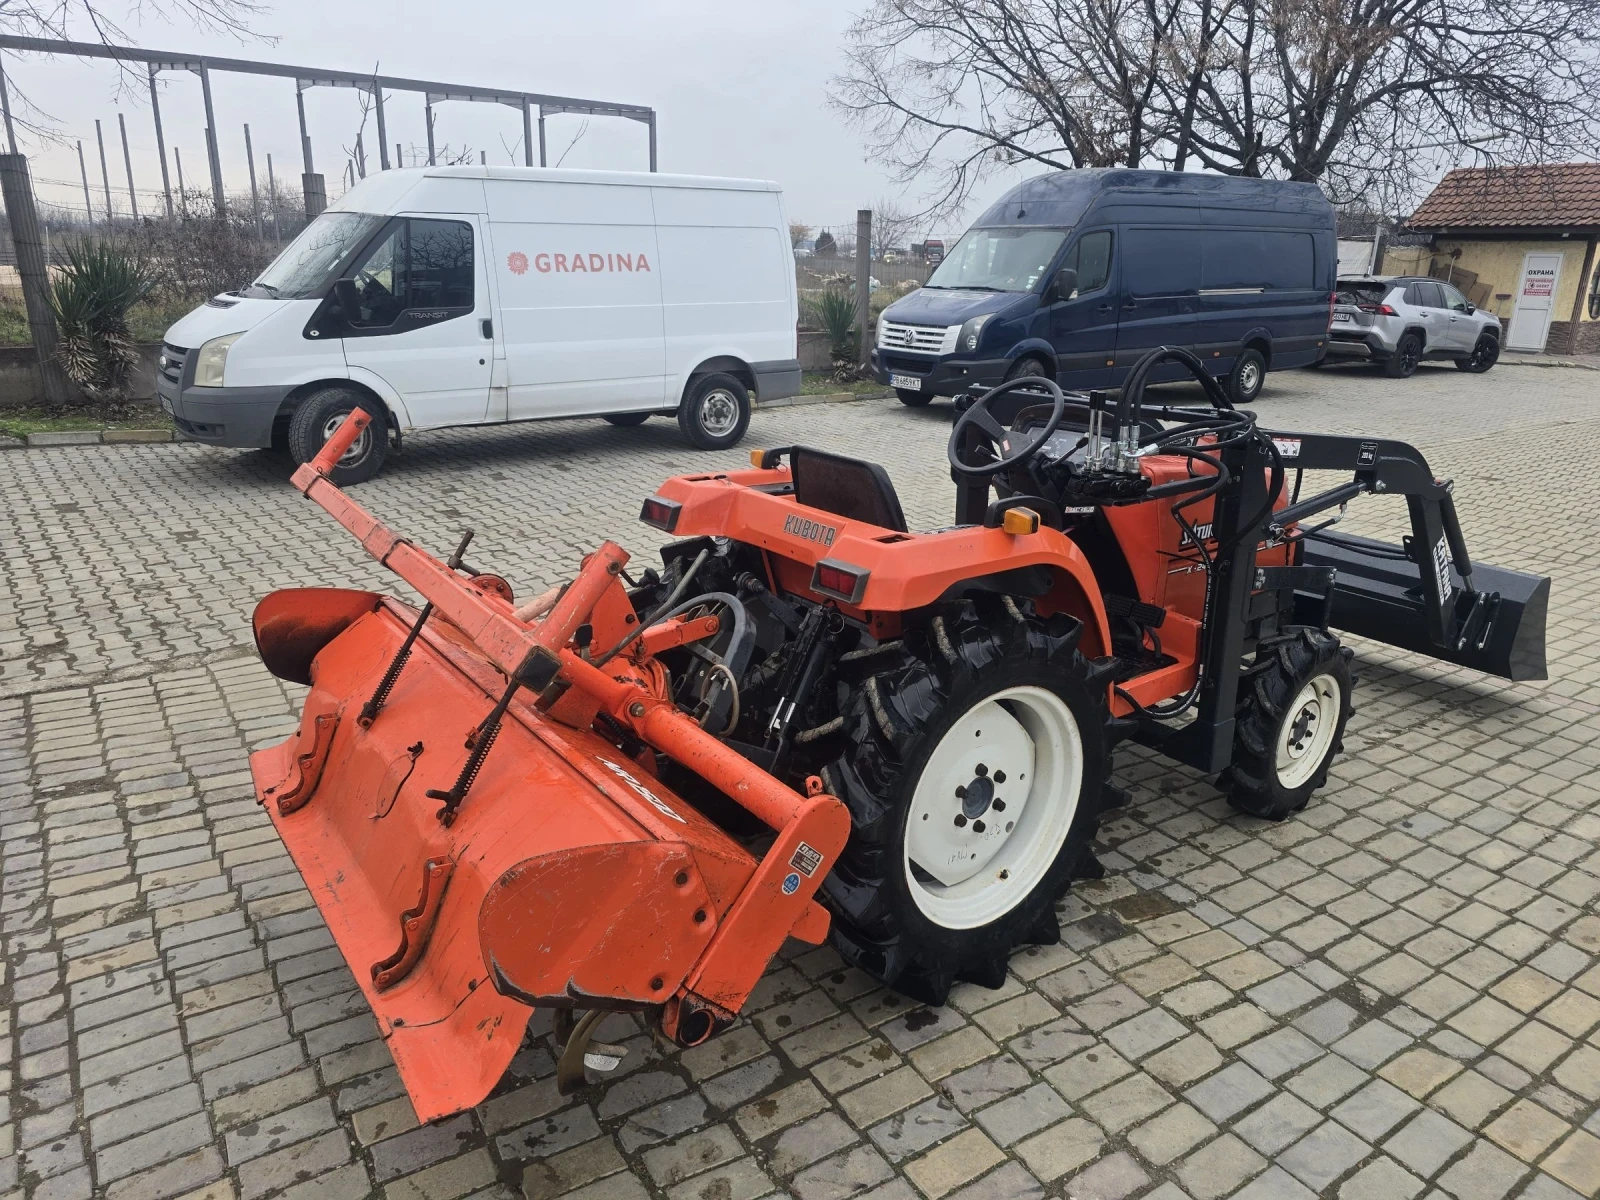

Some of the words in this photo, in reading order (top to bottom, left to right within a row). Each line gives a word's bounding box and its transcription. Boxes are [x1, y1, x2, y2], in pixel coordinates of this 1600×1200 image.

[534, 253, 651, 273] GRADINA
[408, 311, 449, 319] TRANSIT
[783, 514, 836, 547] KUBOTA
[1436, 535, 1452, 600] KATANA
